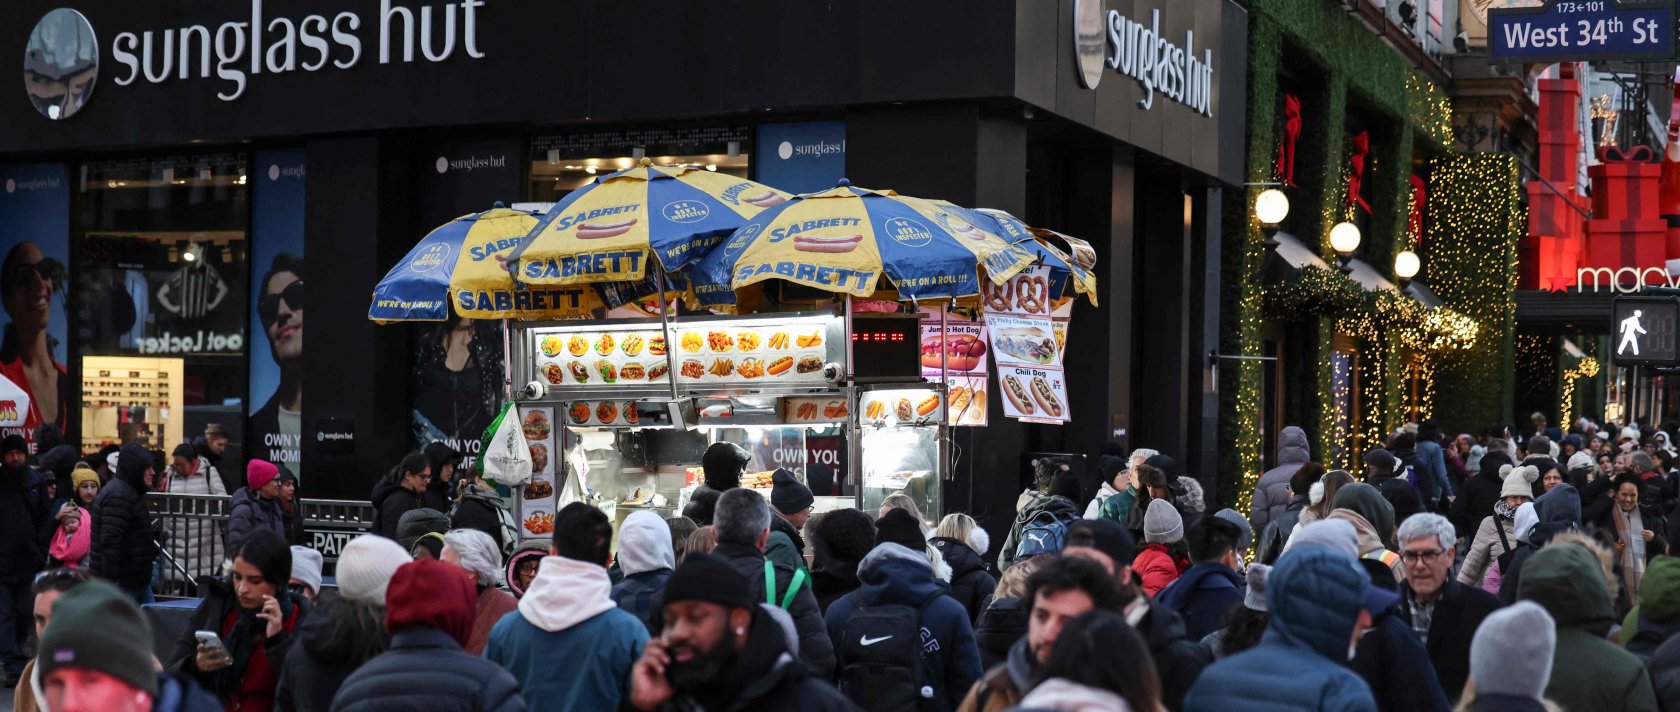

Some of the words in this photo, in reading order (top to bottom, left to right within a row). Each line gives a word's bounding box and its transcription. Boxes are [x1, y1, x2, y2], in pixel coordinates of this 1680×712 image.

[1556, 3, 1576, 13] 173
[1585, 1, 1604, 12] 101
[1504, 23, 1569, 48] West
[1577, 16, 1623, 46] 34th
[1633, 17, 1659, 44] St
[113, 0, 361, 101] sunglass
[379, 0, 485, 64] hut
[1108, 9, 1184, 110] sunglass
[1186, 30, 1213, 118] hut
[796, 140, 840, 158] sunglass
[450, 155, 488, 172] sunglass
[490, 154, 504, 168] hut
[555, 204, 641, 231] SABRETT
[767, 216, 861, 243] SABRETT
[525, 249, 643, 278] SABRETT
[736, 262, 874, 290] SABRETT
[894, 278, 917, 288] WE'RE
[919, 277, 930, 286] ON
[939, 276, 956, 284] ROLL
[958, 275, 968, 283] !!!
[377, 300, 399, 308] WE'RE
[457, 288, 584, 312] SABRETT
[966, 326, 980, 335] Dog
[1015, 368, 1031, 376] Chili
[1032, 369, 1047, 378] Dog
[265, 433, 292, 447] OWN
[270, 449, 300, 462] MOM
[772, 448, 808, 464] OWN
